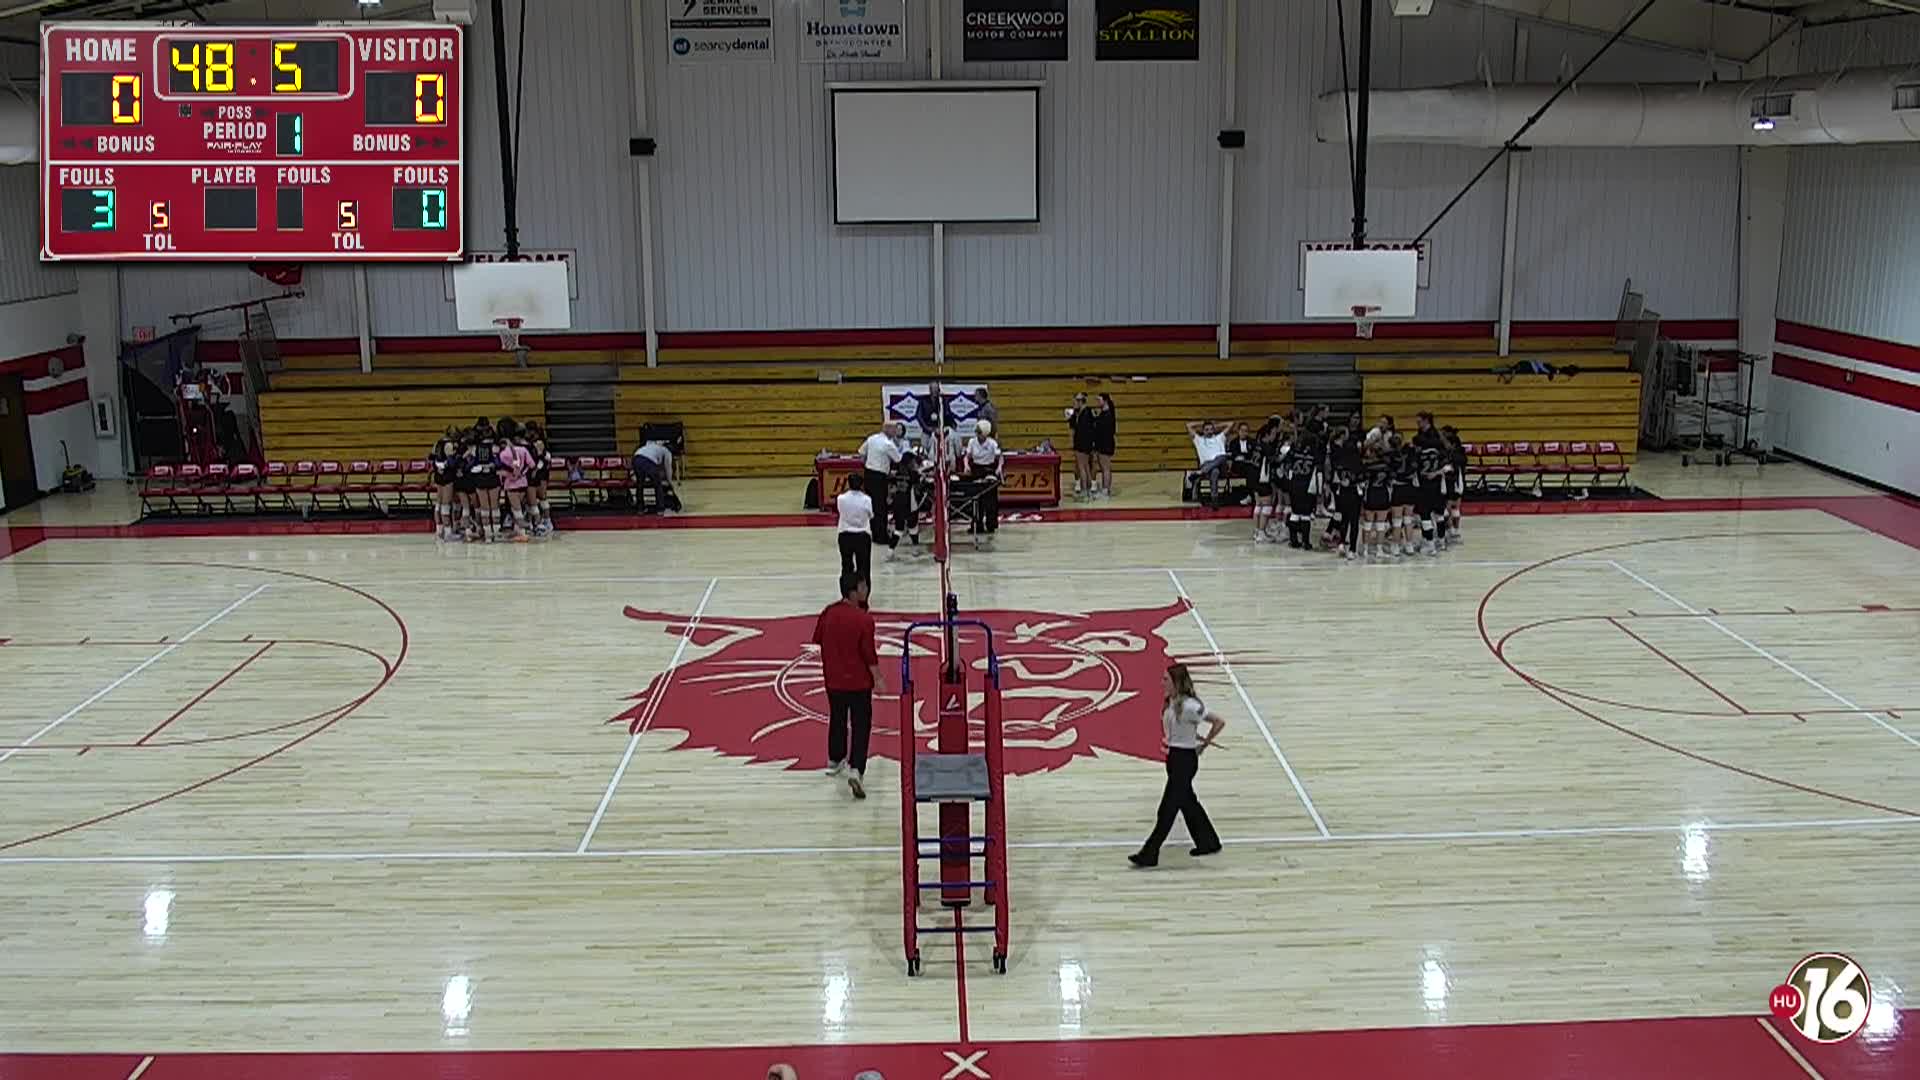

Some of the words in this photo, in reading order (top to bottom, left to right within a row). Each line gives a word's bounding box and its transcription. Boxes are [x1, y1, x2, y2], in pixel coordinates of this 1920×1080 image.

[703, 5, 757, 15] SERVICES
[966, 11, 1064, 28] CREEKWOOD
[806, 21, 899, 35] Hometown
[967, 30, 1005, 39] MOTOR
[1009, 30, 1063, 39] COMPANY
[1099, 28, 1195, 41] STALLION
